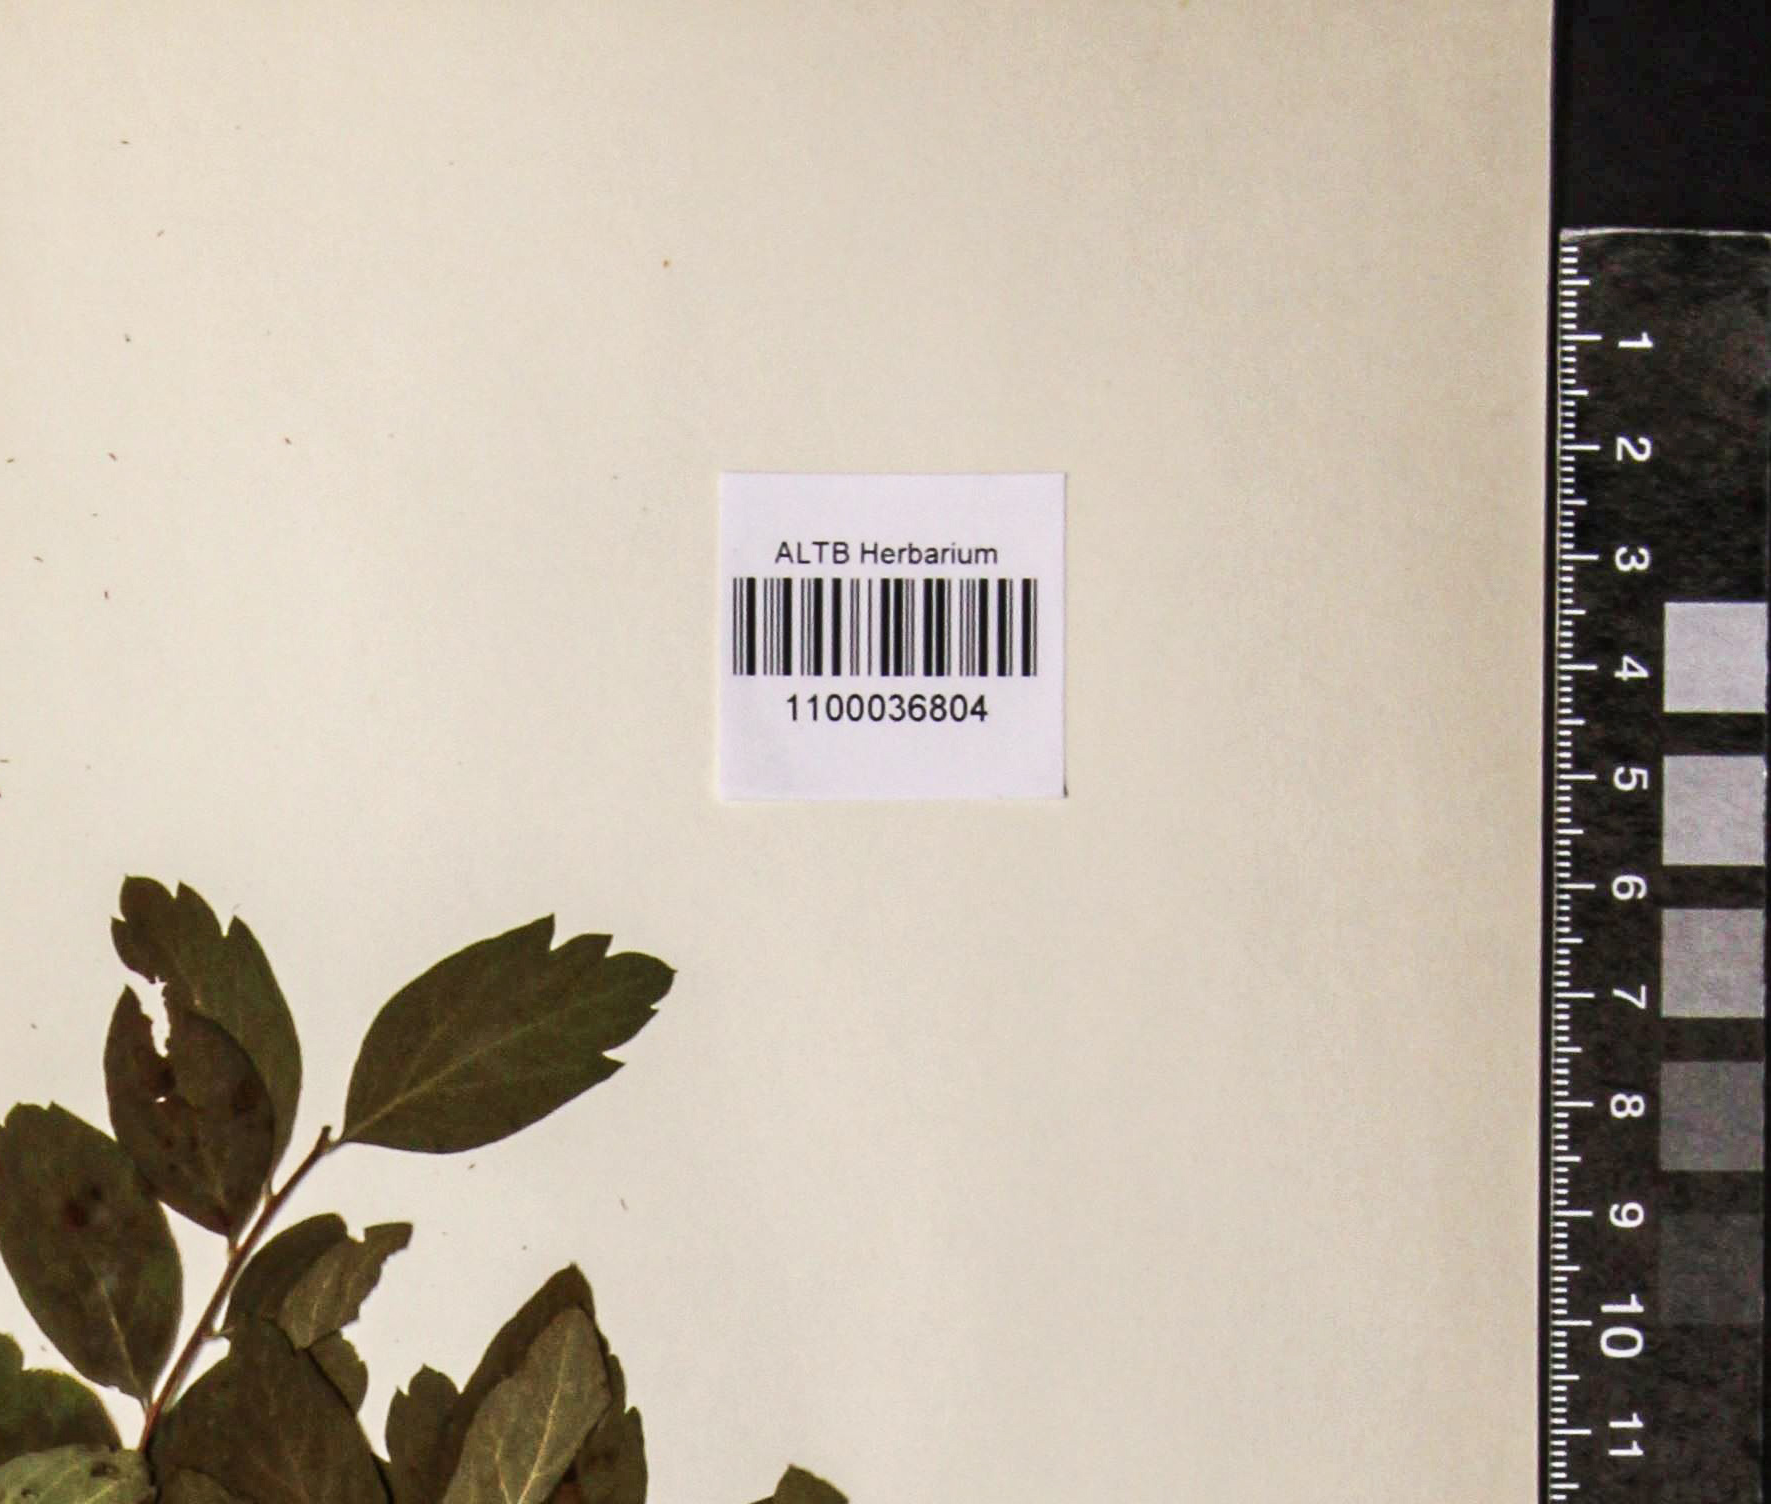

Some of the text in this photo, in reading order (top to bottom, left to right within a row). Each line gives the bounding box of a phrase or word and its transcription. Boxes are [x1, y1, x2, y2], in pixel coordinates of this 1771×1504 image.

[1617, 331, 1654, 349] 1
[1616, 436, 1652, 462] 2
[775, 541, 998, 565] ALTB Herbarium
[1614, 546, 1651, 572] 3
[1614, 655, 1649, 681] 4
[786, 693, 989, 722] 1100036804
[1612, 766, 1649, 792] 5
[1611, 874, 1648, 901] 6
[1612, 984, 1647, 1010] 7
[1609, 1092, 1646, 1119] 8
[1608, 1201, 1645, 1229] 9
[1599, 1293, 1645, 1359] 10
[1608, 1412, 1644, 1457] 11
